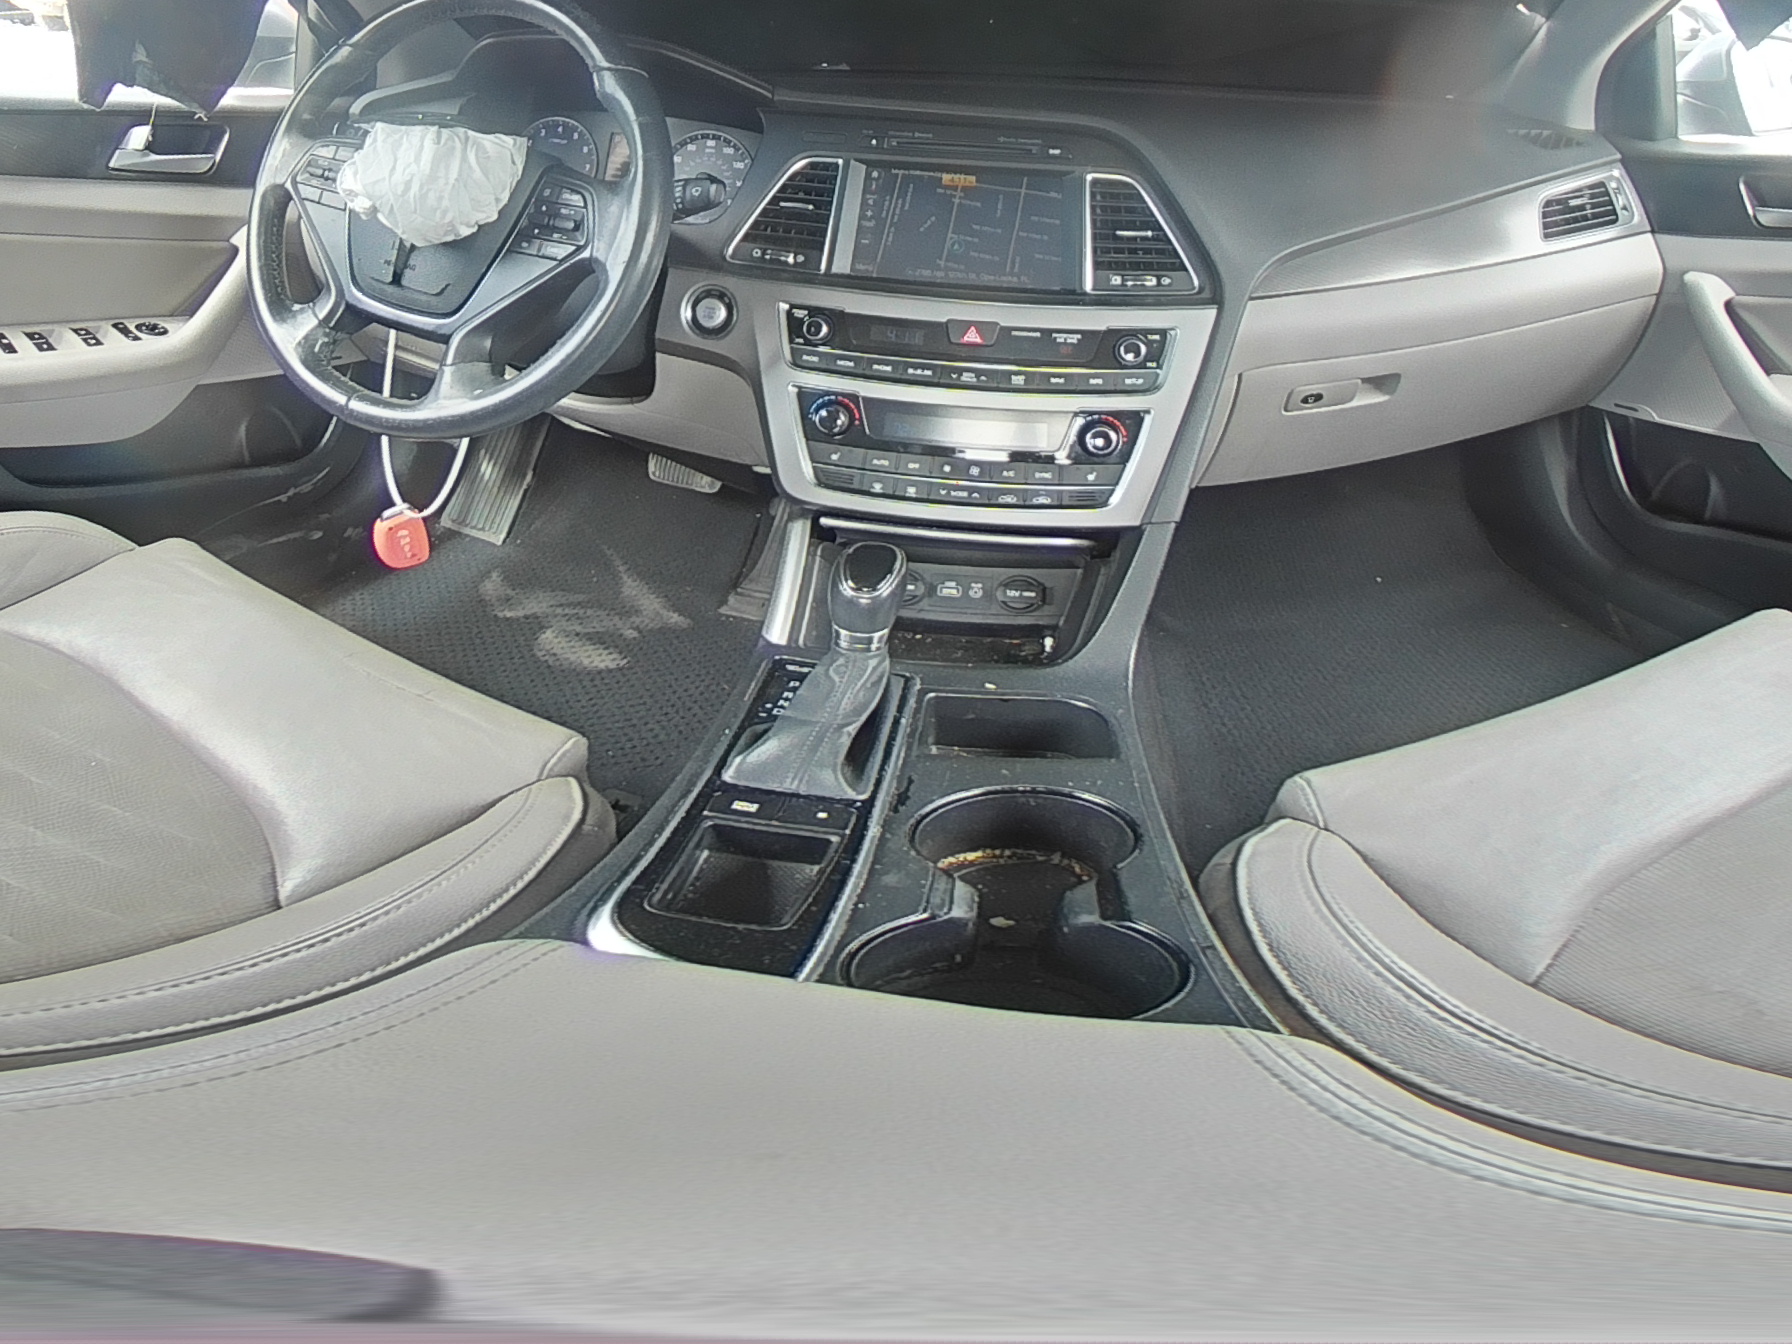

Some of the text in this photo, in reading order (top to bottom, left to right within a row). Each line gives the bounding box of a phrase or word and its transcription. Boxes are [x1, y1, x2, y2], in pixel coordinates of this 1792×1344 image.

[557, 126, 563, 135] 4
[788, 680, 801, 688] P
[772, 707, 785, 715] D
